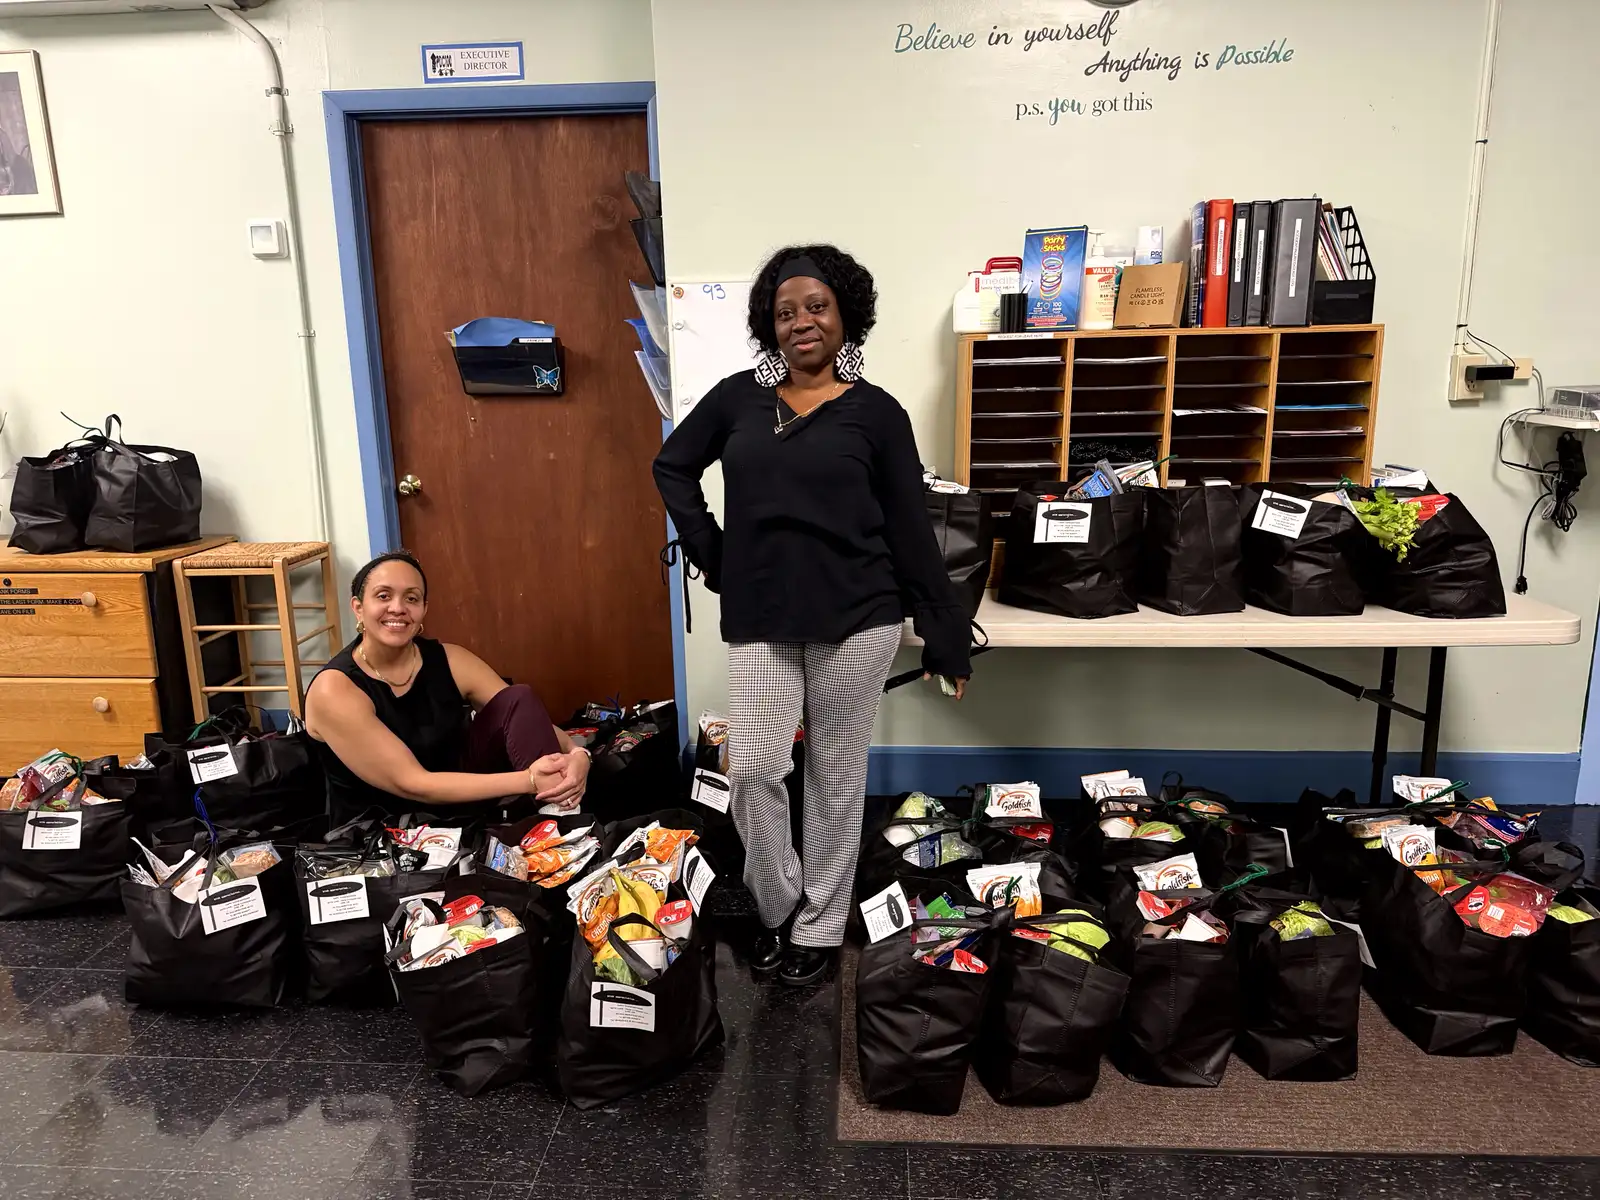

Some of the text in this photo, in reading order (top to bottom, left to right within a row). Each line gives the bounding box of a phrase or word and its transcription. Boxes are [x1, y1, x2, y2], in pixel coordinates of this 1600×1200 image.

[894, 10, 1118, 53] Believe in yourself
[460, 50, 510, 59] EXECUTIVE
[1084, 38, 1294, 82] Anything is Possible
[464, 61, 508, 70] DIRECTOR
[1016, 91, 1153, 126] p.s. you got this
[1043, 235, 1066, 244] Party
[1043, 244, 1066, 252] Sticks
[702, 284, 726, 300] 93
[1001, 798, 1032, 812] Goldfish
[1405, 842, 1431, 864] Goldfish
